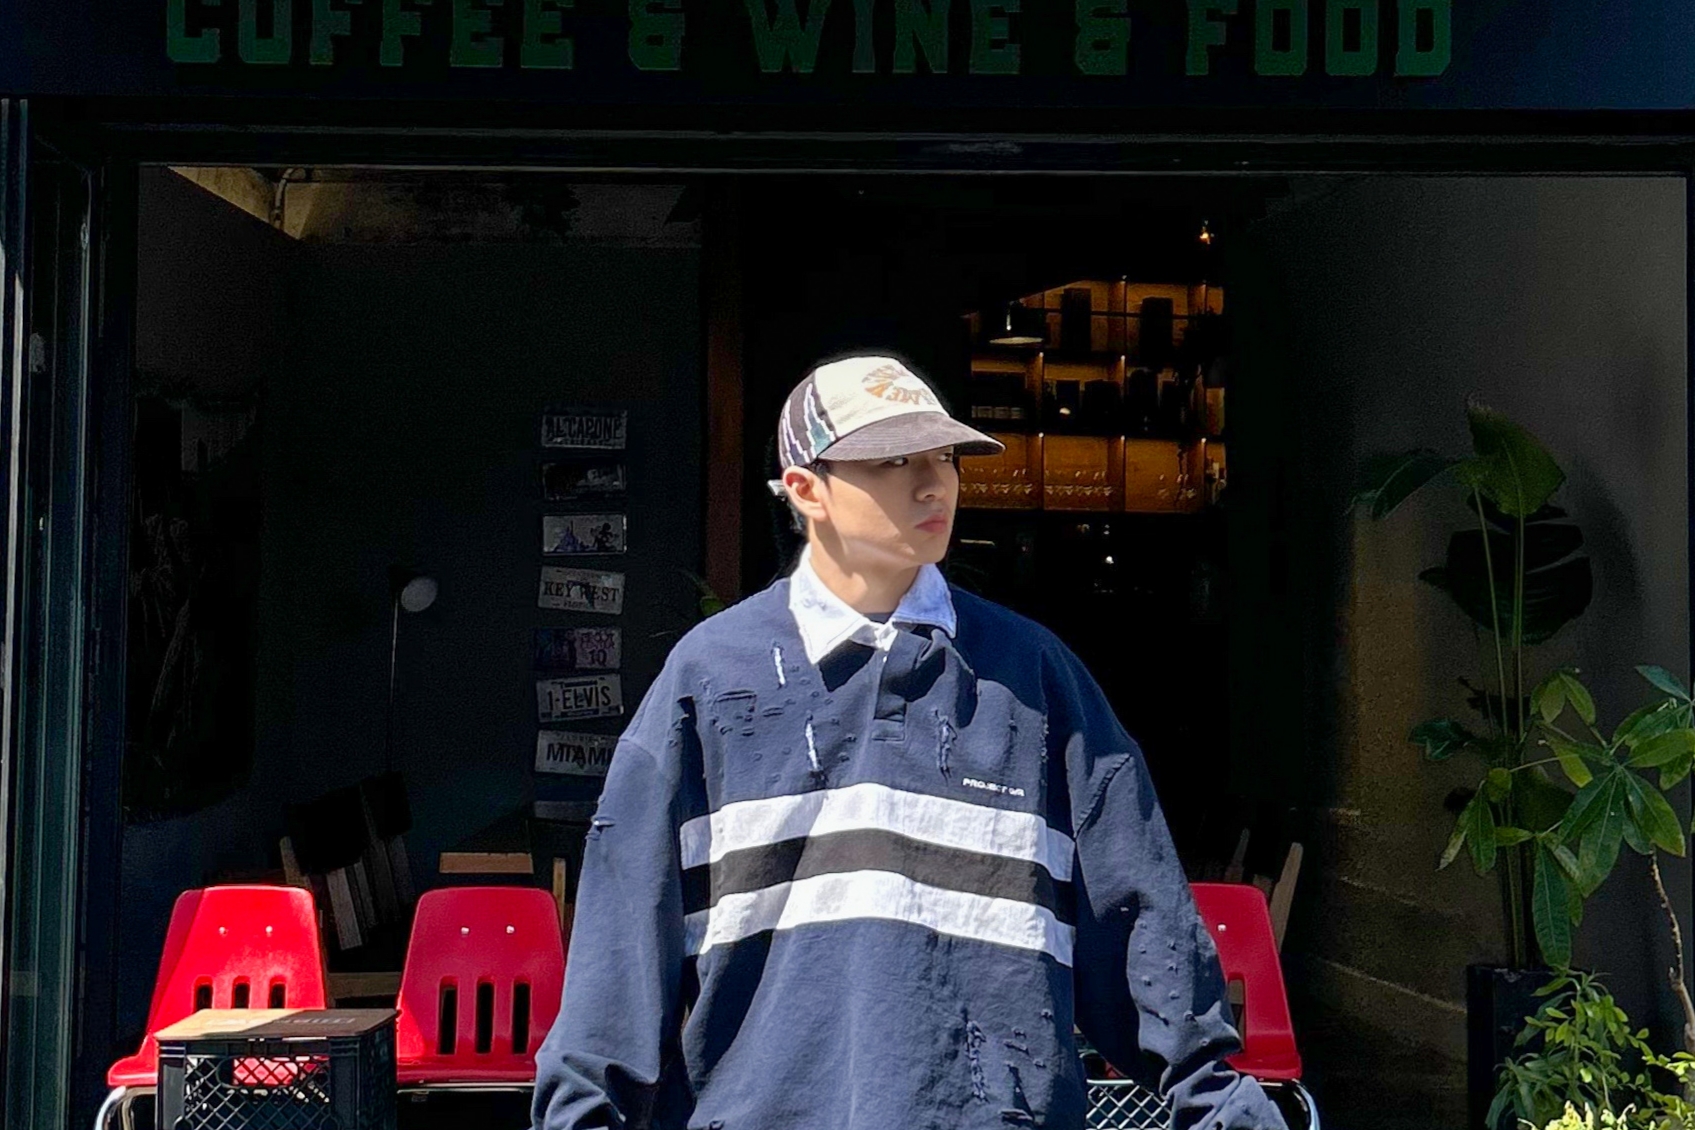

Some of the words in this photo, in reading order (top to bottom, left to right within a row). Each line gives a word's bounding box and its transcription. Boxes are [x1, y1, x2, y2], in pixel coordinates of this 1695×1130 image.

[166, 0, 574, 70] COFFEE
[627, 0, 684, 71] &
[749, 0, 1022, 75] WINE
[1073, 0, 1132, 76] &
[1186, 0, 1452, 77] FOOD
[543, 581, 573, 598] KEY
